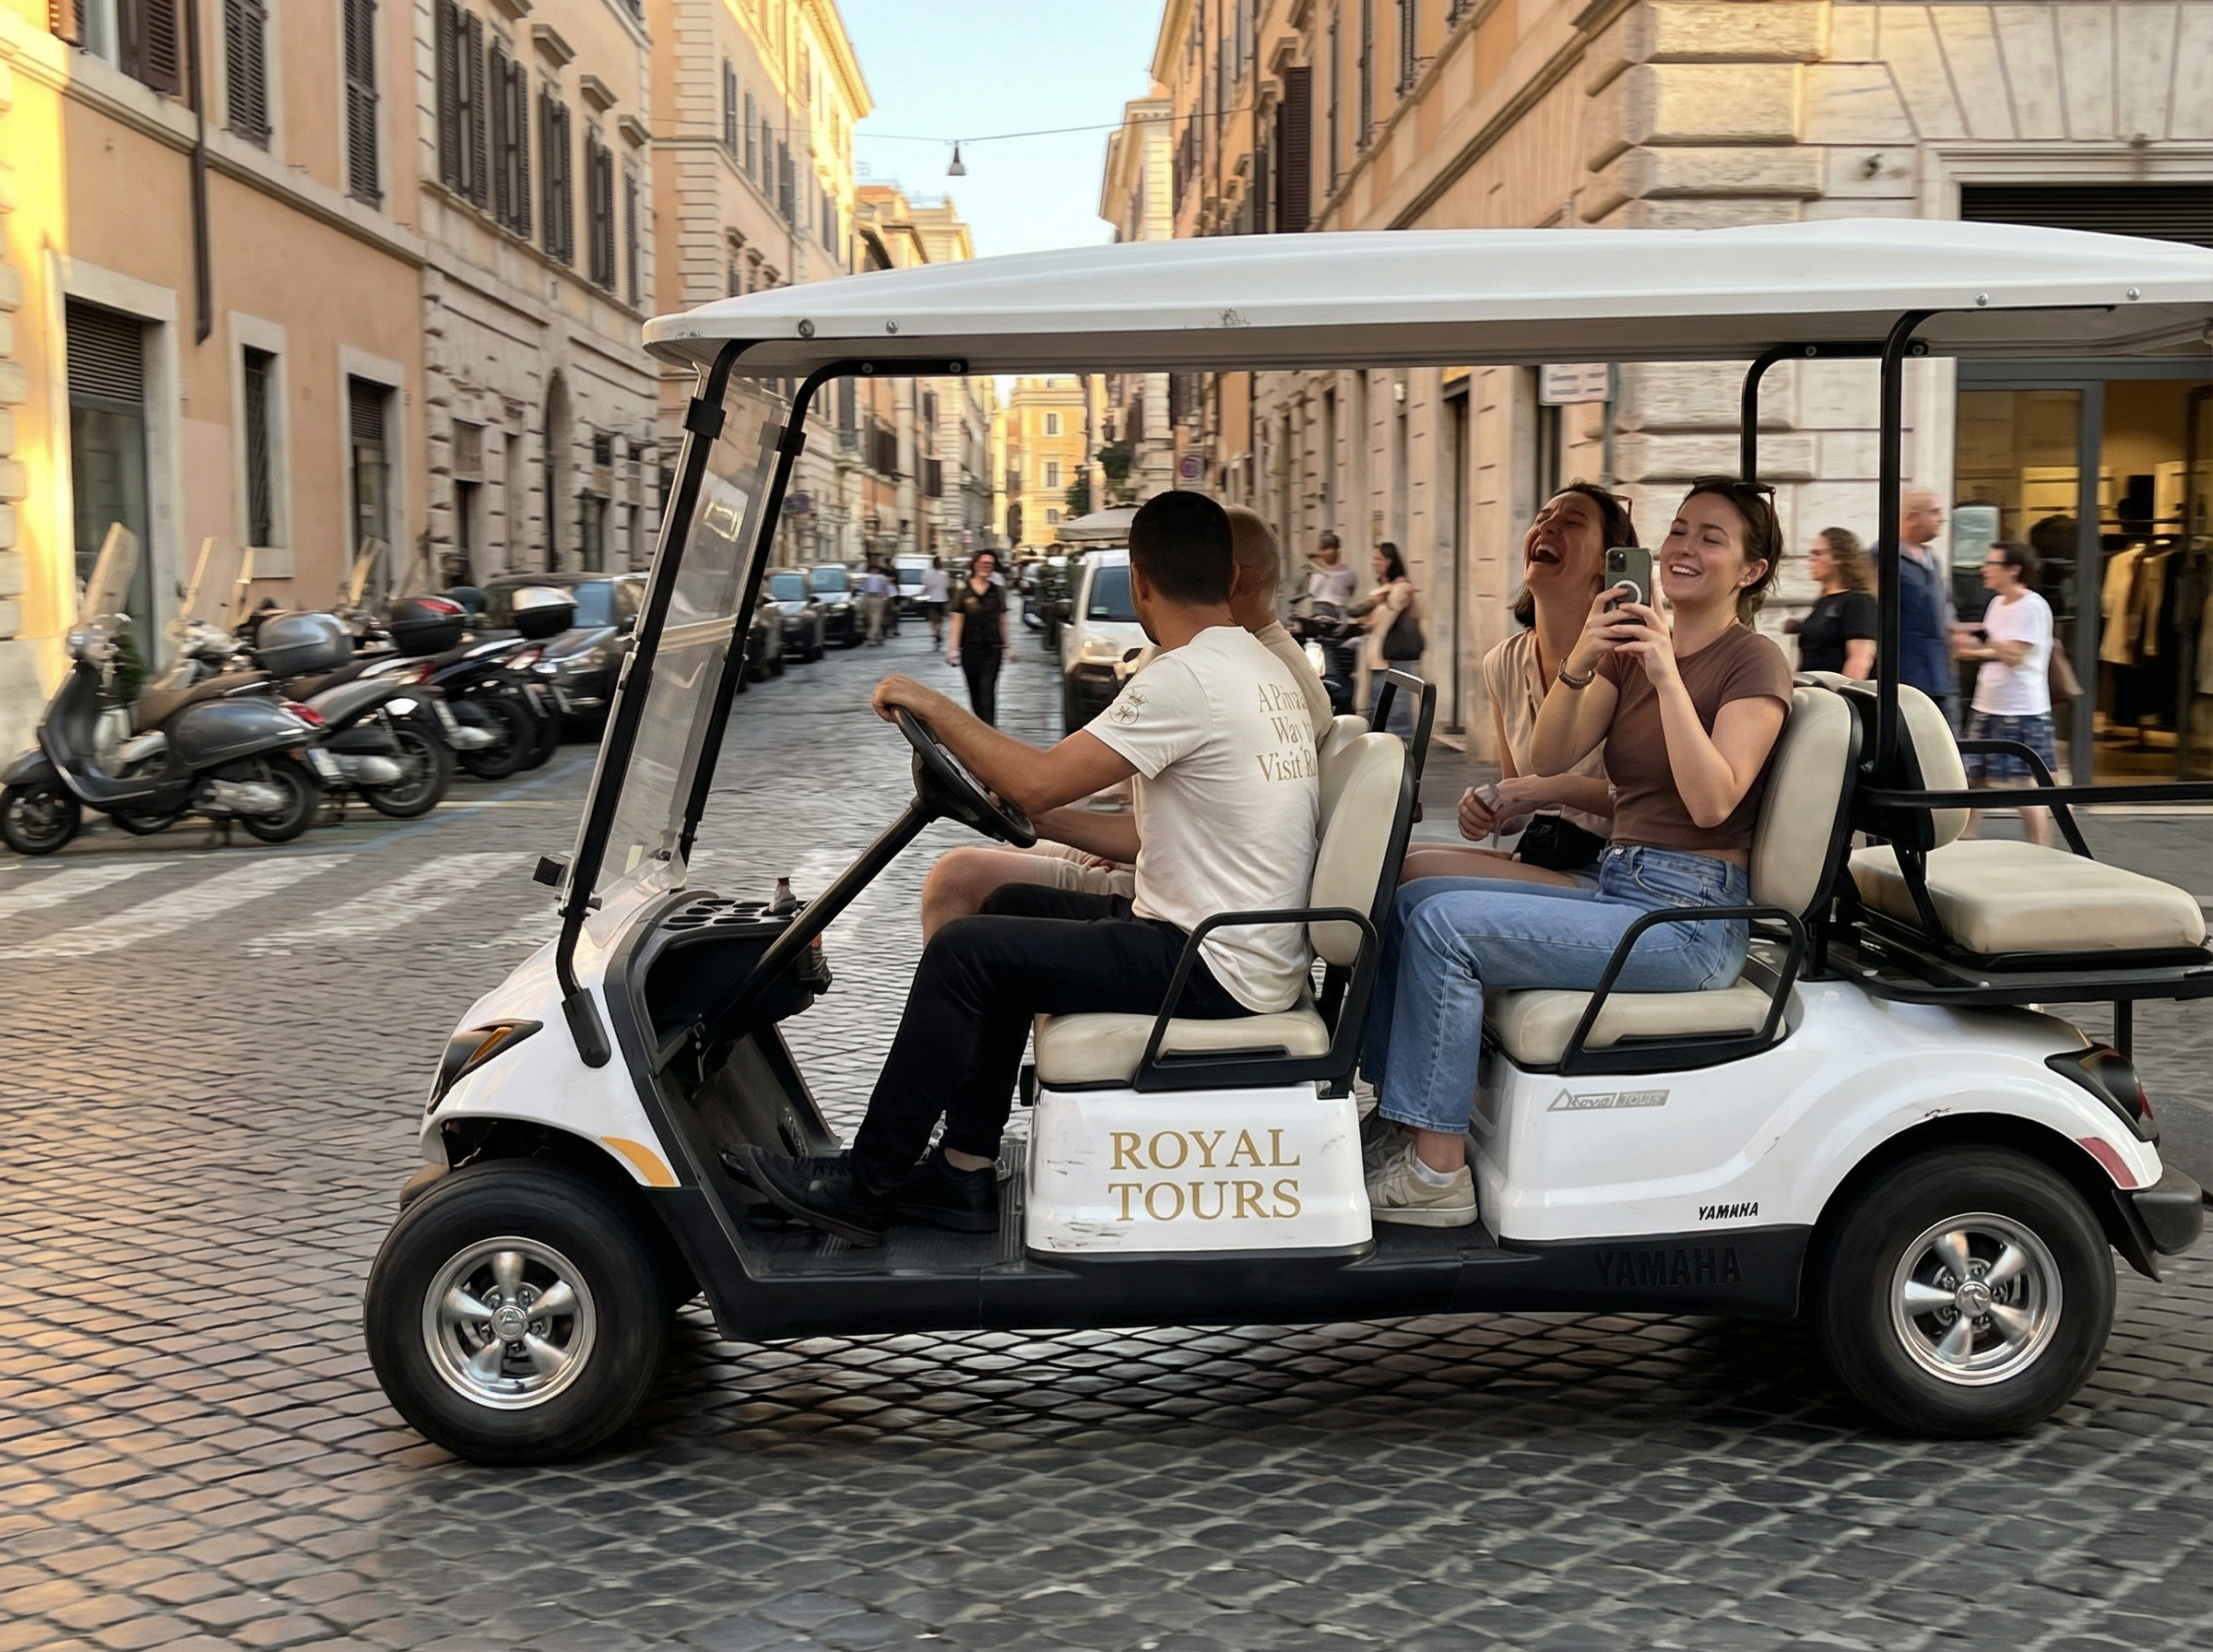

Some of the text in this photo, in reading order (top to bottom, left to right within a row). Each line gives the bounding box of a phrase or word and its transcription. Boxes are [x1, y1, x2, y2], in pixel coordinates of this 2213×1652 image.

[1257, 682, 1273, 714] A
[1270, 716, 1304, 749] Way
[1256, 750, 1303, 783] Visit
[1109, 1128, 1301, 1170] ROYAL
[1107, 1178, 1302, 1221] TOURS
[1592, 1245, 1743, 1289] YAMAHA
